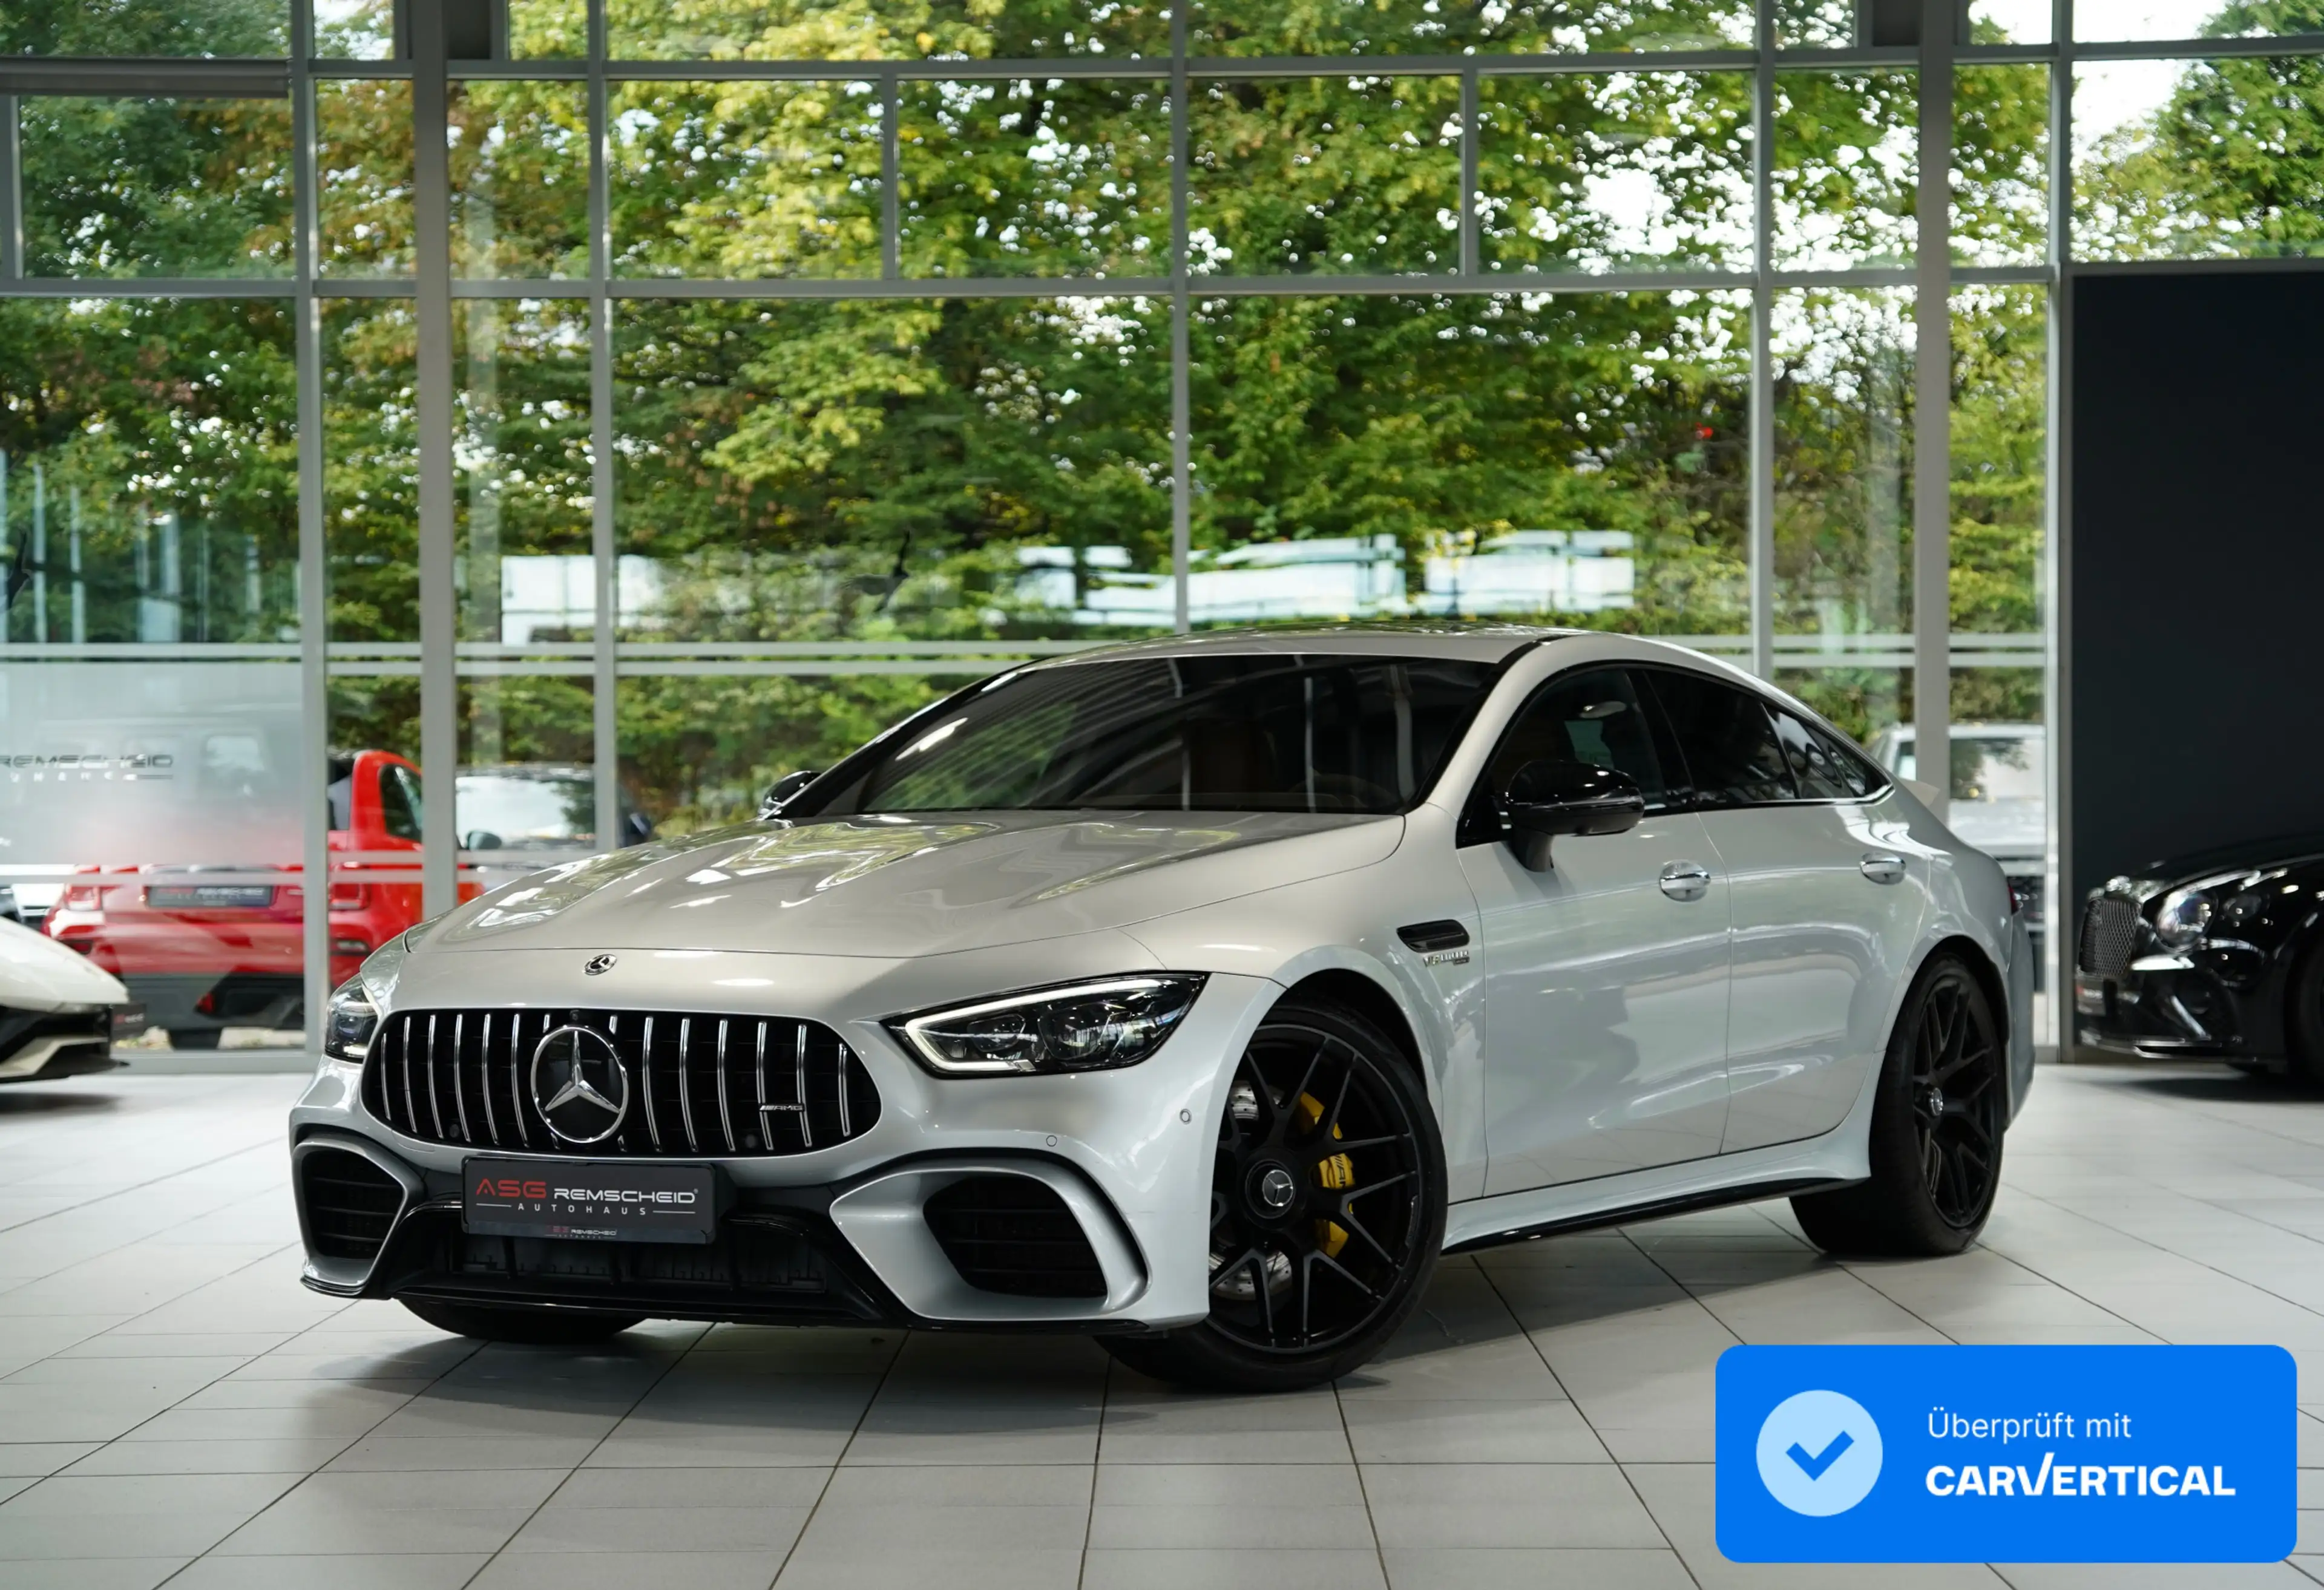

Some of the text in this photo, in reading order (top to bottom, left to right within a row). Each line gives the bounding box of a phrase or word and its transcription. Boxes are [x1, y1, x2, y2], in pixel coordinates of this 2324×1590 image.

[475, 1178, 695, 1204] ASG REMSCHEID
[517, 1202, 646, 1215] AUTOHAUS
